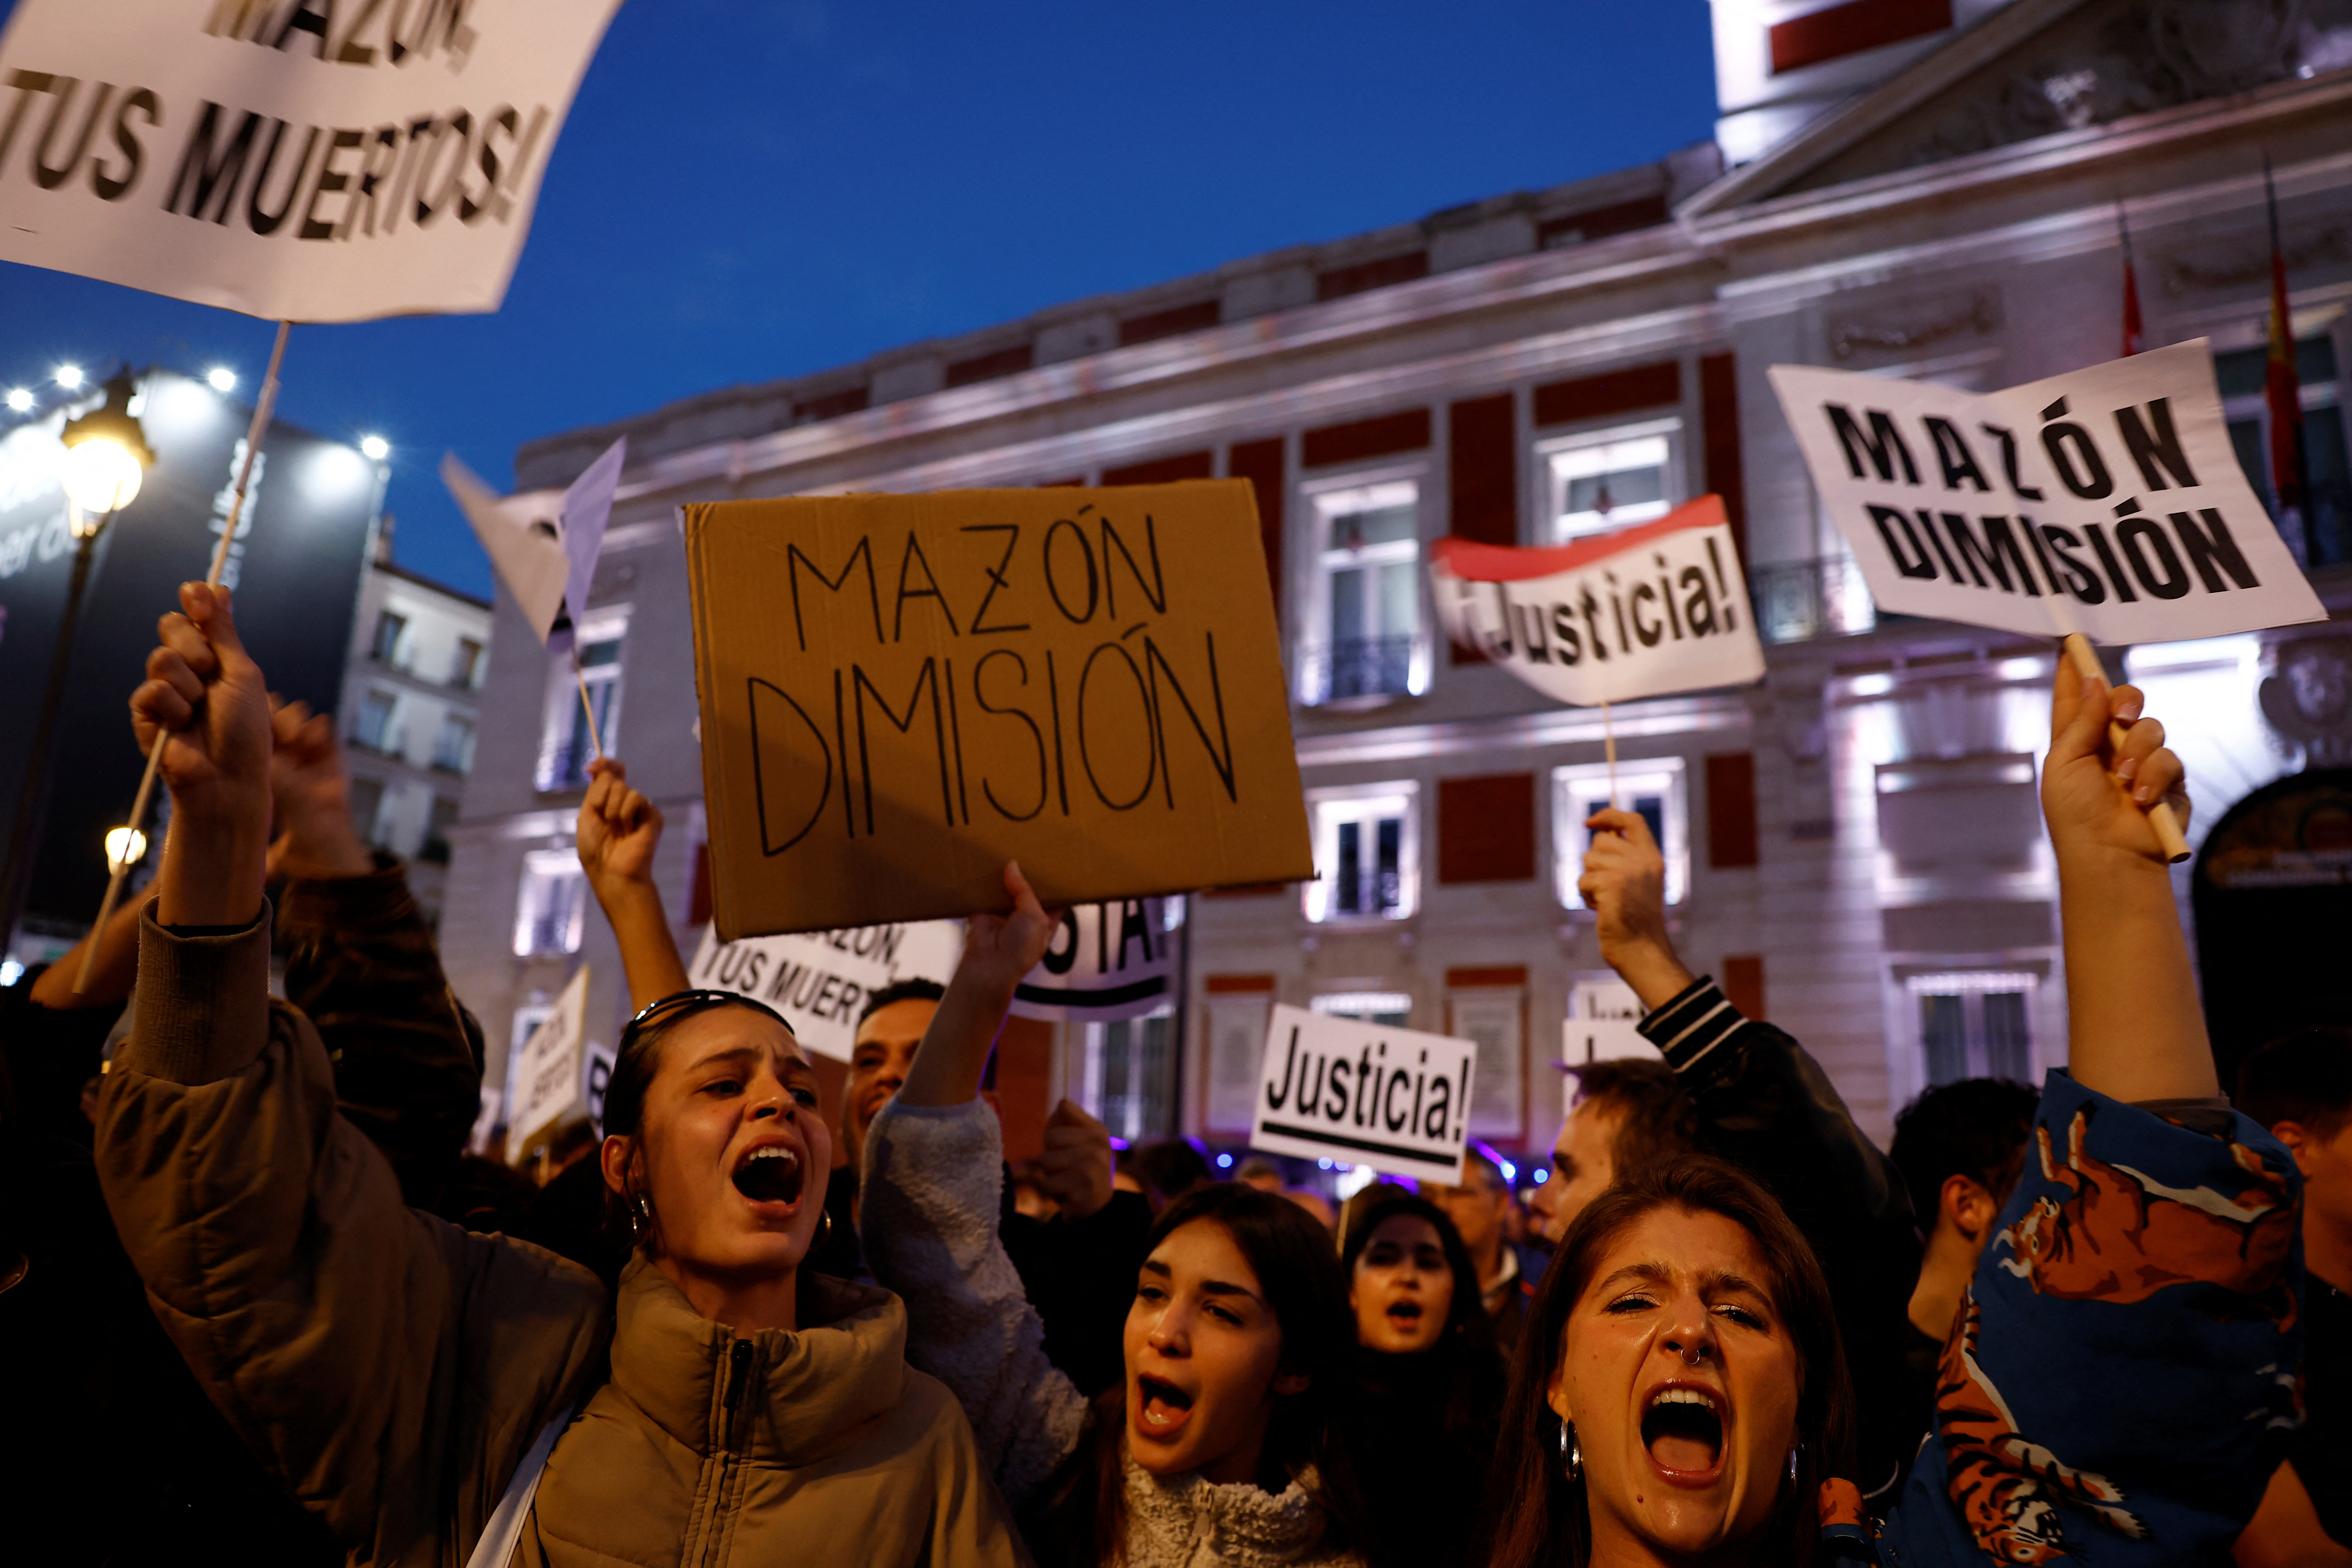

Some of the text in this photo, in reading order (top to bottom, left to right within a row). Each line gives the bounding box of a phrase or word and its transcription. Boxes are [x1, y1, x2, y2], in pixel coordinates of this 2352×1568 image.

[0, 68, 555, 242] TUS MUERTOS!
[1822, 393, 2201, 502] MAZÓN
[787, 504, 1166, 652] MAZÓN
[1865, 496, 2261, 605] DIMISIÓN
[747, 623, 1237, 858] DIMISIÓN
[704, 943, 767, 992] TUS
[1267, 1024, 1470, 1143] Justicia!
